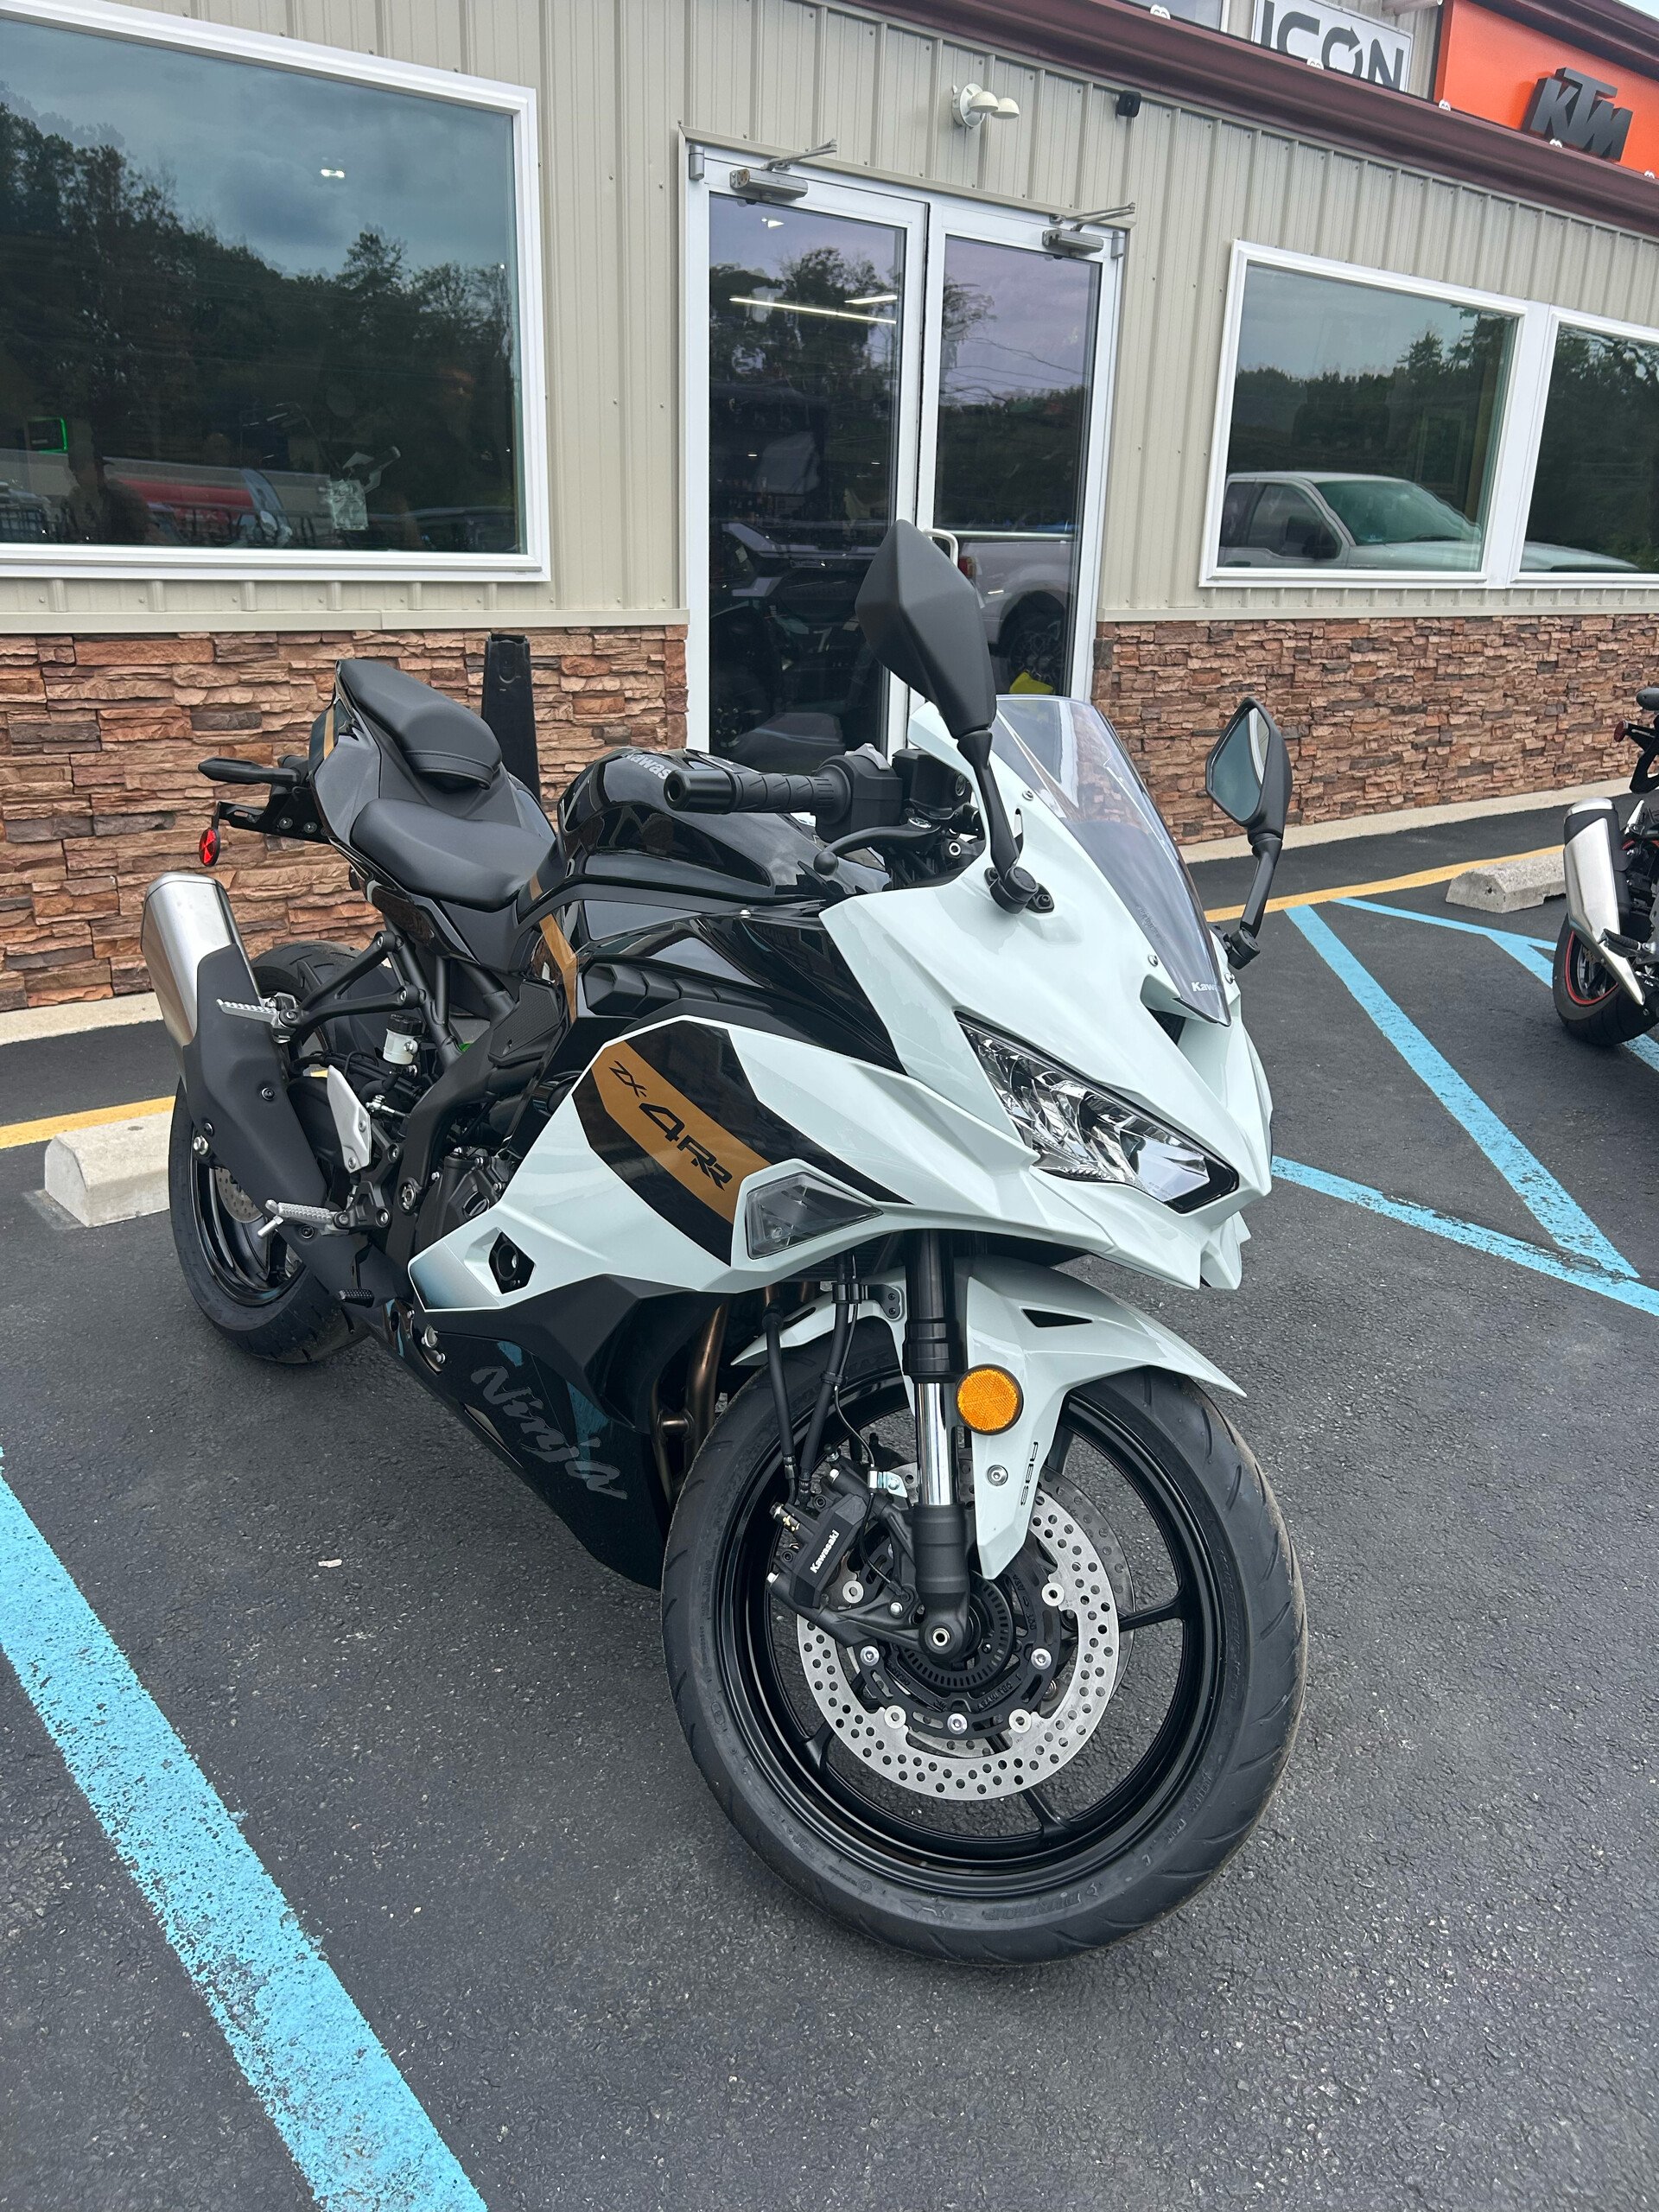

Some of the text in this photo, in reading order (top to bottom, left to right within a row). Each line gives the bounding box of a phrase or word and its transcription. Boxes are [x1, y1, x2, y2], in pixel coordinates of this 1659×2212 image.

[1261, 1, 1404, 90] ICON
[1524, 67, 1631, 162] KTM
[470, 1365, 628, 1500] Ninja
[810, 1529, 840, 1573] Kawasaki
